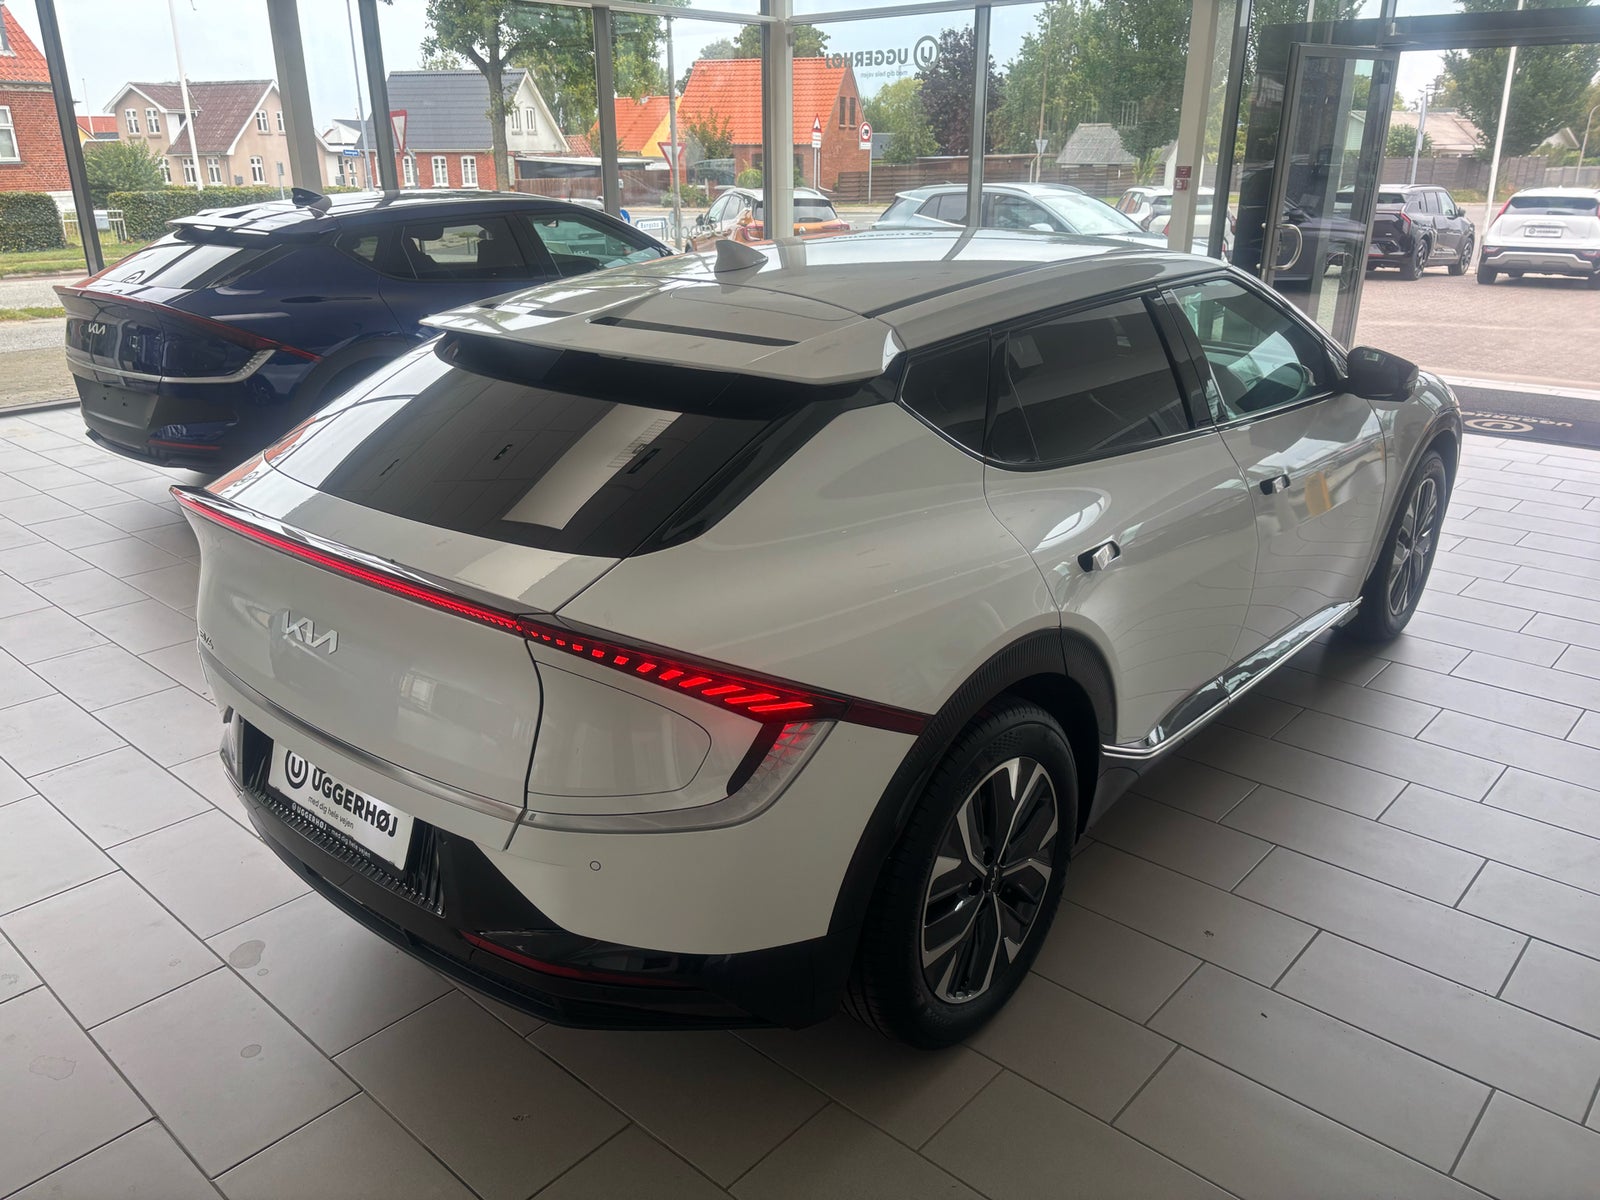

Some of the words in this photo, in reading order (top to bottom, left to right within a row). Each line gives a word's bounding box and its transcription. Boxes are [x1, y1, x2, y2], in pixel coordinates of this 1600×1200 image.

[88, 322, 106, 335] KIA
[281, 609, 339, 655] KIA
[308, 795, 320, 808] med
[319, 802, 328, 815] dig
[327, 806, 340, 820] hele
[340, 814, 355, 830] vejen
[312, 767, 398, 837] UGGERHØJ
